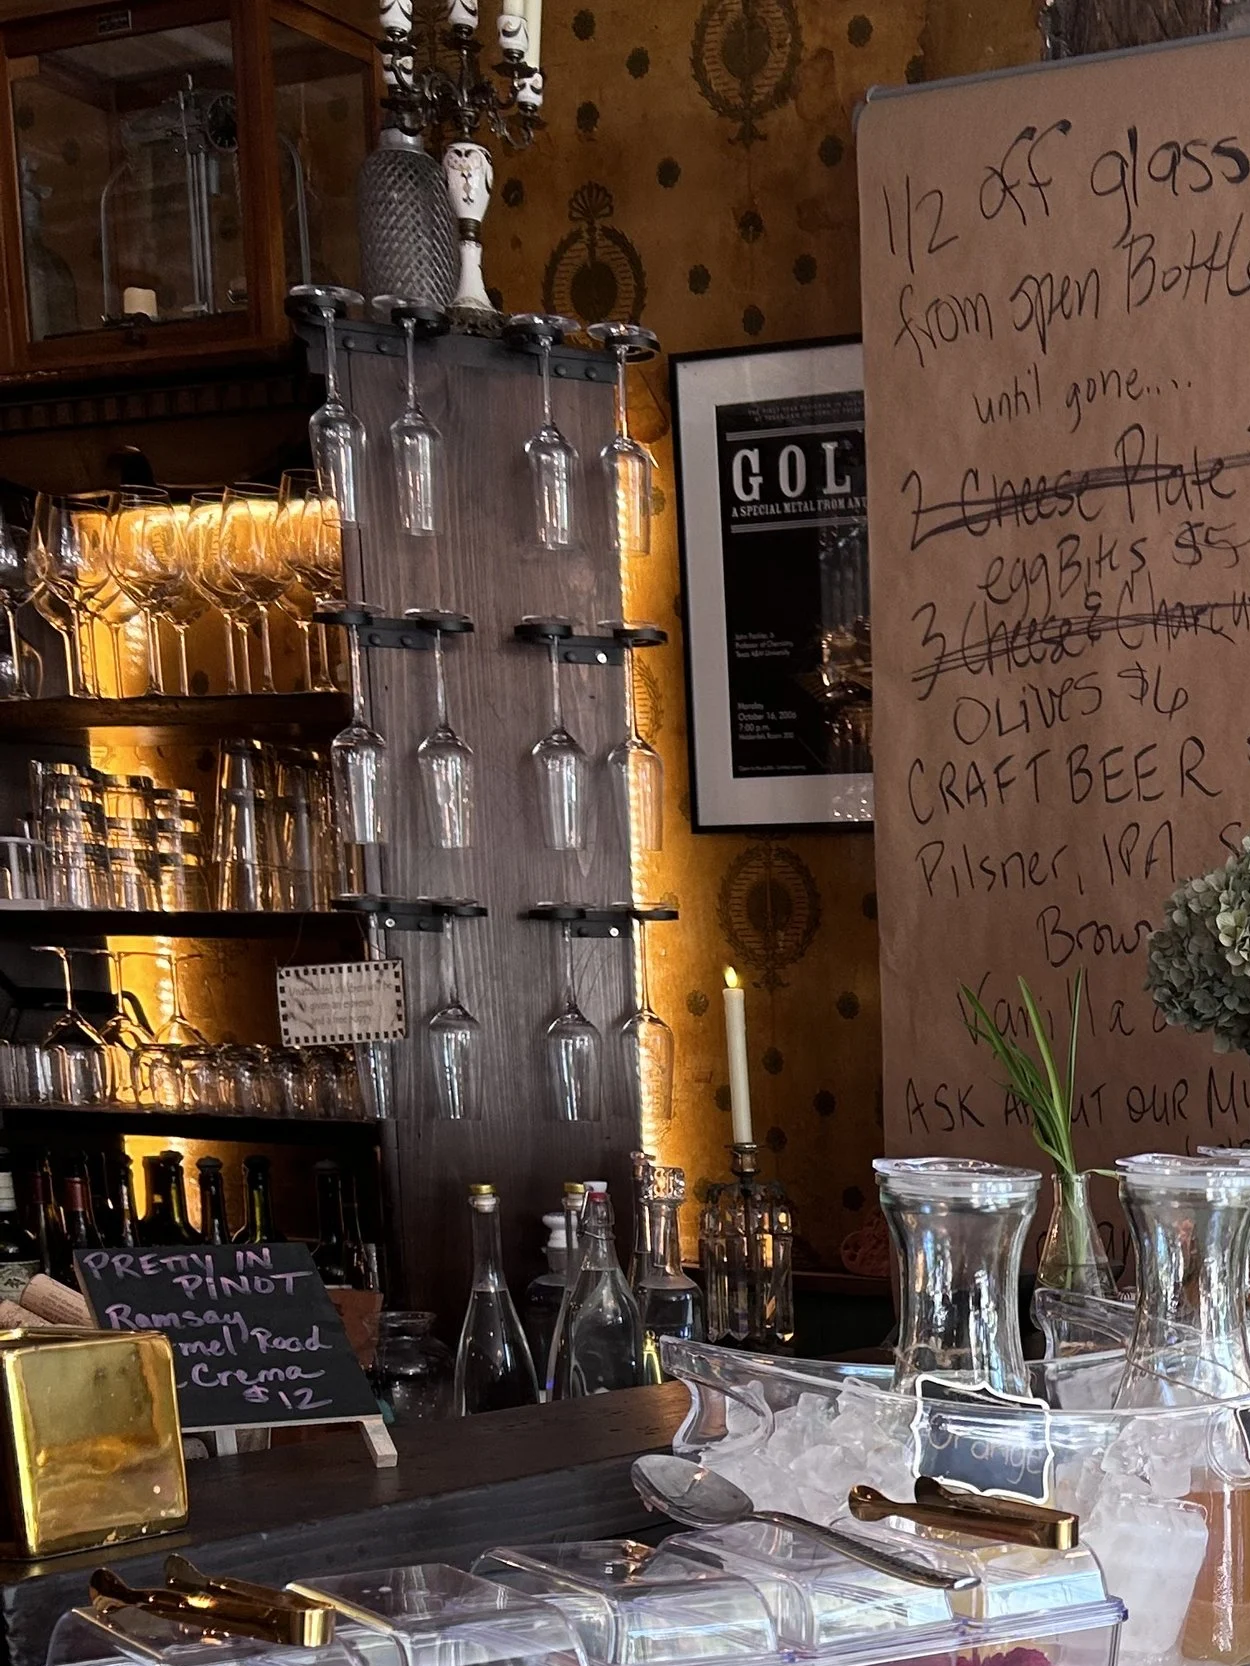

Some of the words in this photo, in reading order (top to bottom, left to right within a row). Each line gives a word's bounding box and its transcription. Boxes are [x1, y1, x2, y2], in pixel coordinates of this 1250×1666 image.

[979, 119, 1071, 225] off
[1090, 126, 1250, 247] glass
[894, 284, 993, 367] from
[1009, 268, 1100, 354] open
[973, 362, 1042, 424] until
[732, 441, 851, 502] GOL
[1114, 424, 1238, 523] Plate
[732, 507, 738, 518] A
[740, 502, 780, 517] SPECIAL
[784, 500, 815, 513] METAL
[818, 496, 845, 511] FROM
[1172, 520, 1239, 570] $5
[1117, 661, 1188, 721] $6
[907, 749, 1051, 826] CRAFT
[1066, 736, 1223, 805] BEER
[1101, 819, 1176, 886] IPA
[957, 967, 1136, 1046] Vanilla
[906, 1077, 985, 1135] ASK
[1004, 1083, 1107, 1128] AUT
[1126, 1079, 1190, 1128] OUR
[84, 1251, 213, 1281] PRETTY
[236, 1248, 273, 1273] IN
[173, 1271, 313, 1301] PINOT
[105, 1304, 249, 1344] Ramsay
[174, 1325, 238, 1357] mel
[250, 1325, 333, 1354] Road
[191, 1362, 326, 1388] Crema
[928, 1413, 1043, 1485] Orange
